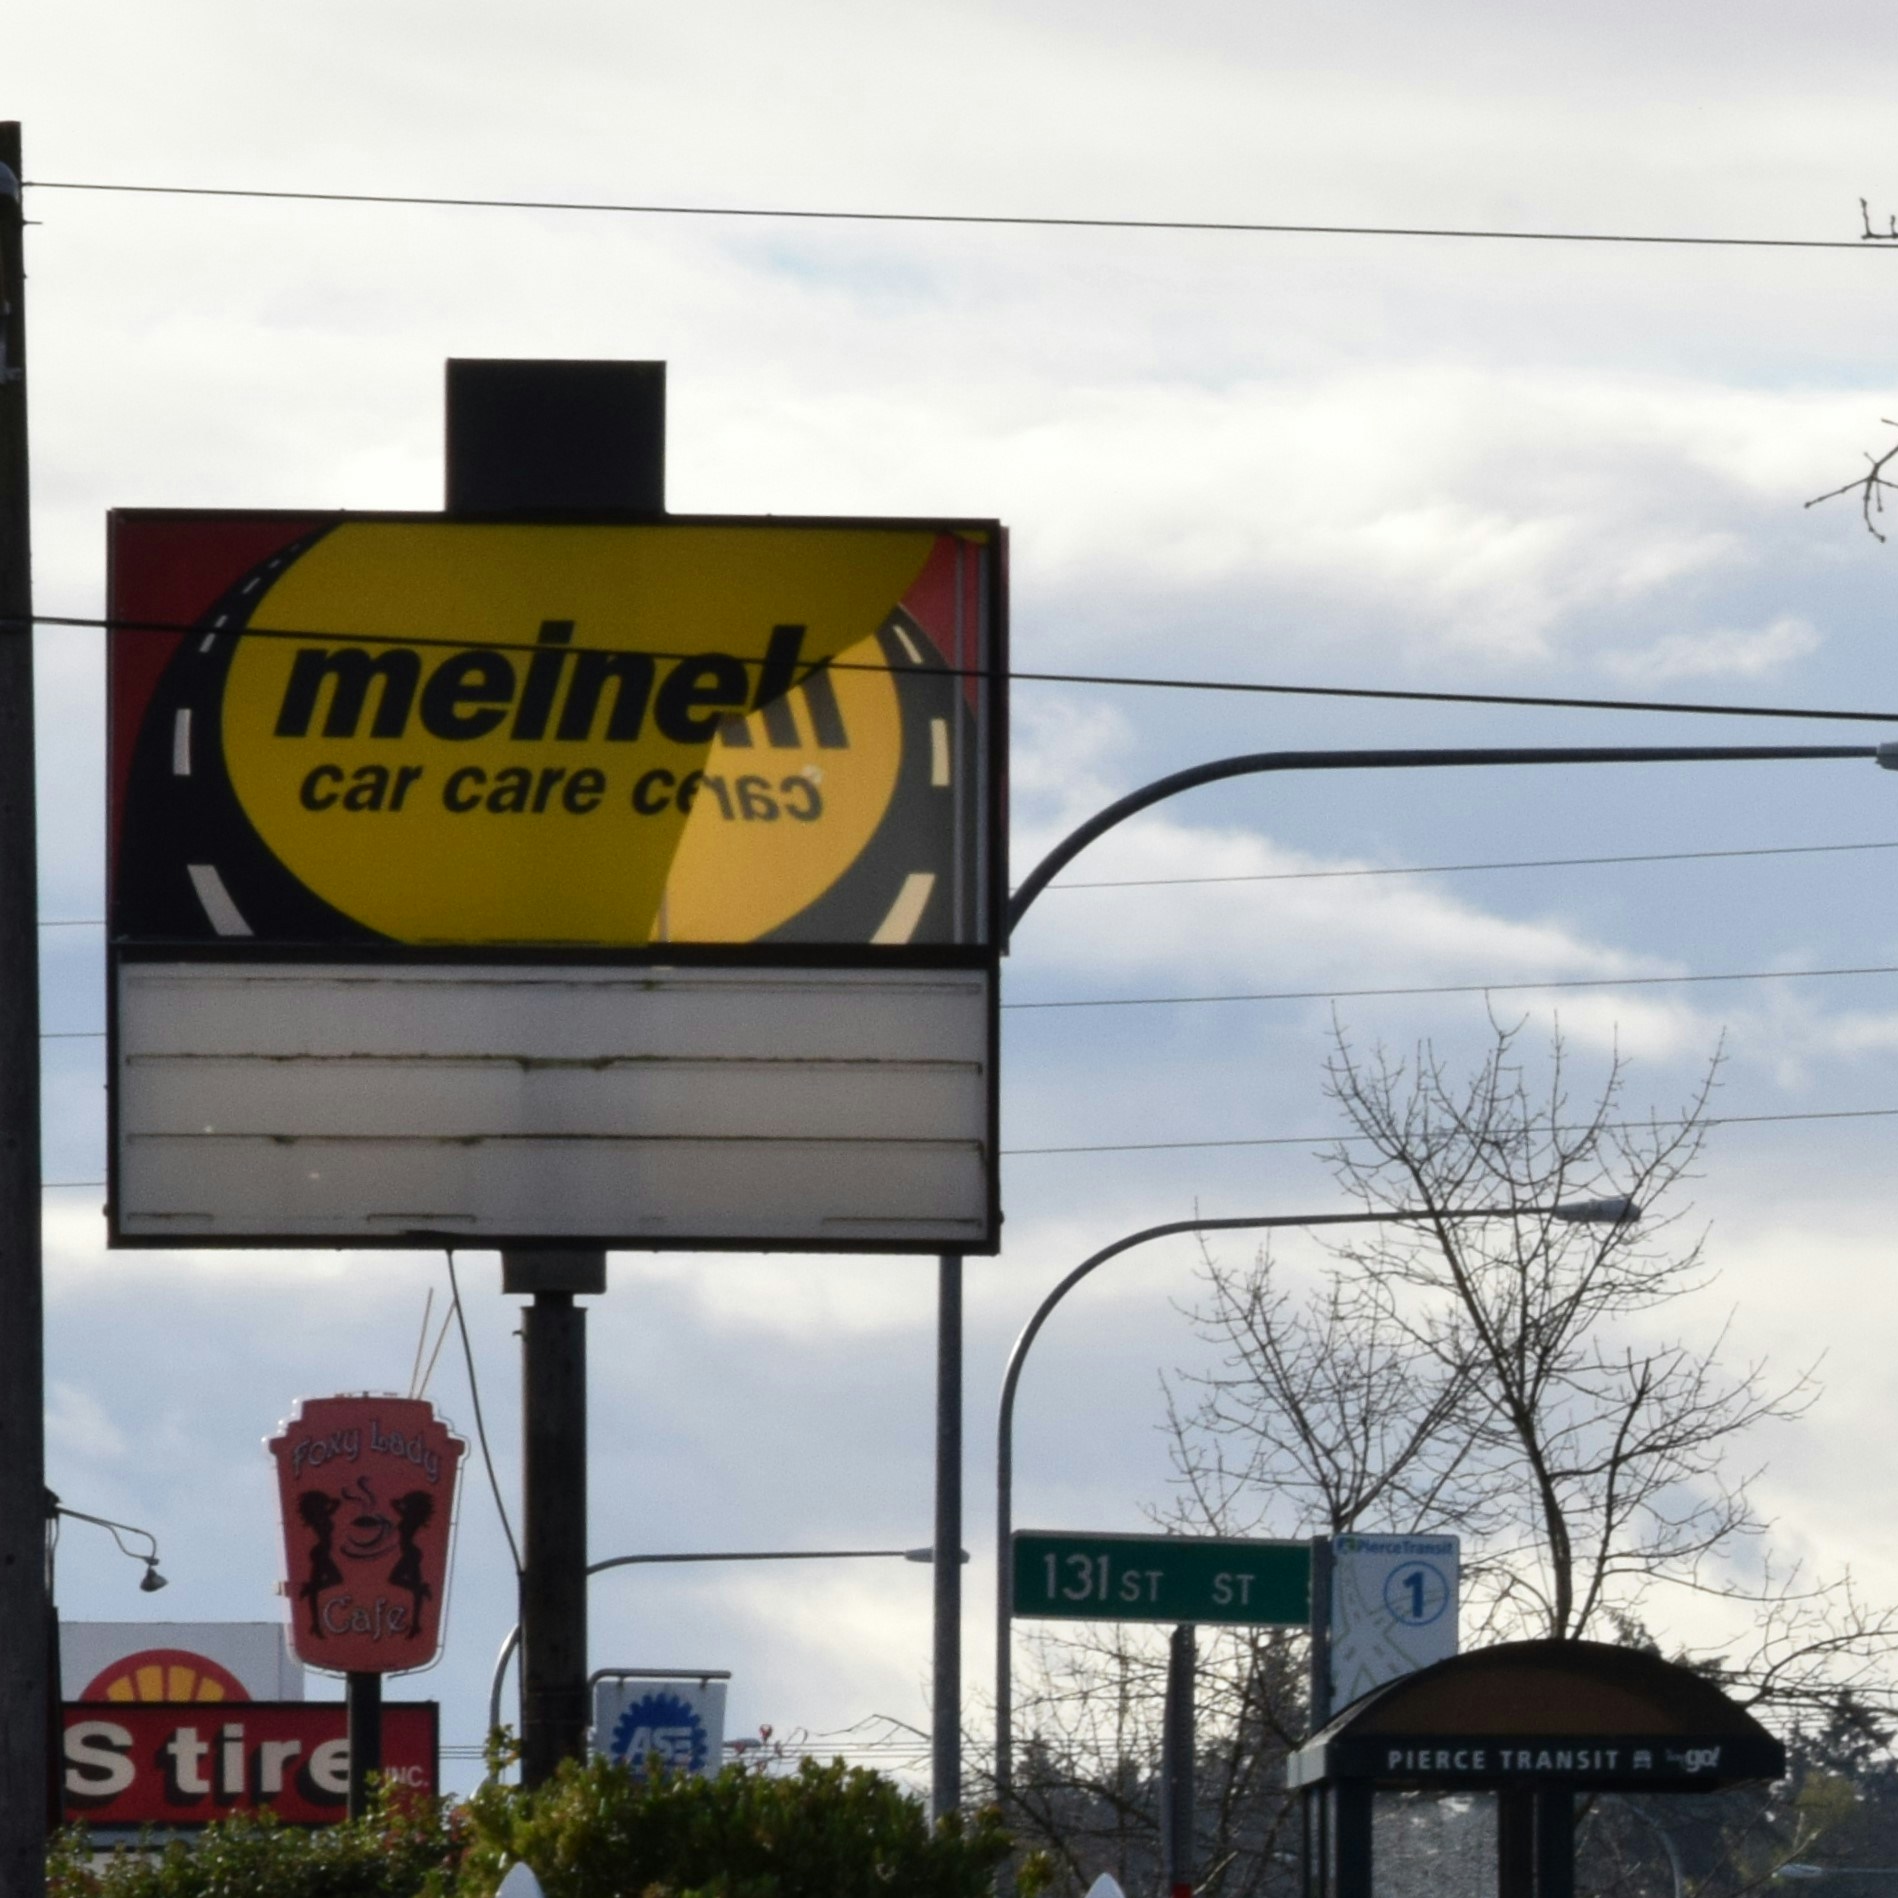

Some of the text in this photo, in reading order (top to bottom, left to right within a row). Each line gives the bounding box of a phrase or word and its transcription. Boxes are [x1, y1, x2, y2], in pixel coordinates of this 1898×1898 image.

[299, 763, 424, 814] car
[442, 765, 606, 815] care
[292, 1418, 441, 1484] Foxy Lady
[1211, 1573, 1256, 1605] ST
[1402, 1570, 1423, 1618] 1
[1387, 1749, 1487, 1770] PIERCE
[1501, 1749, 1620, 1770] TRANSIT
